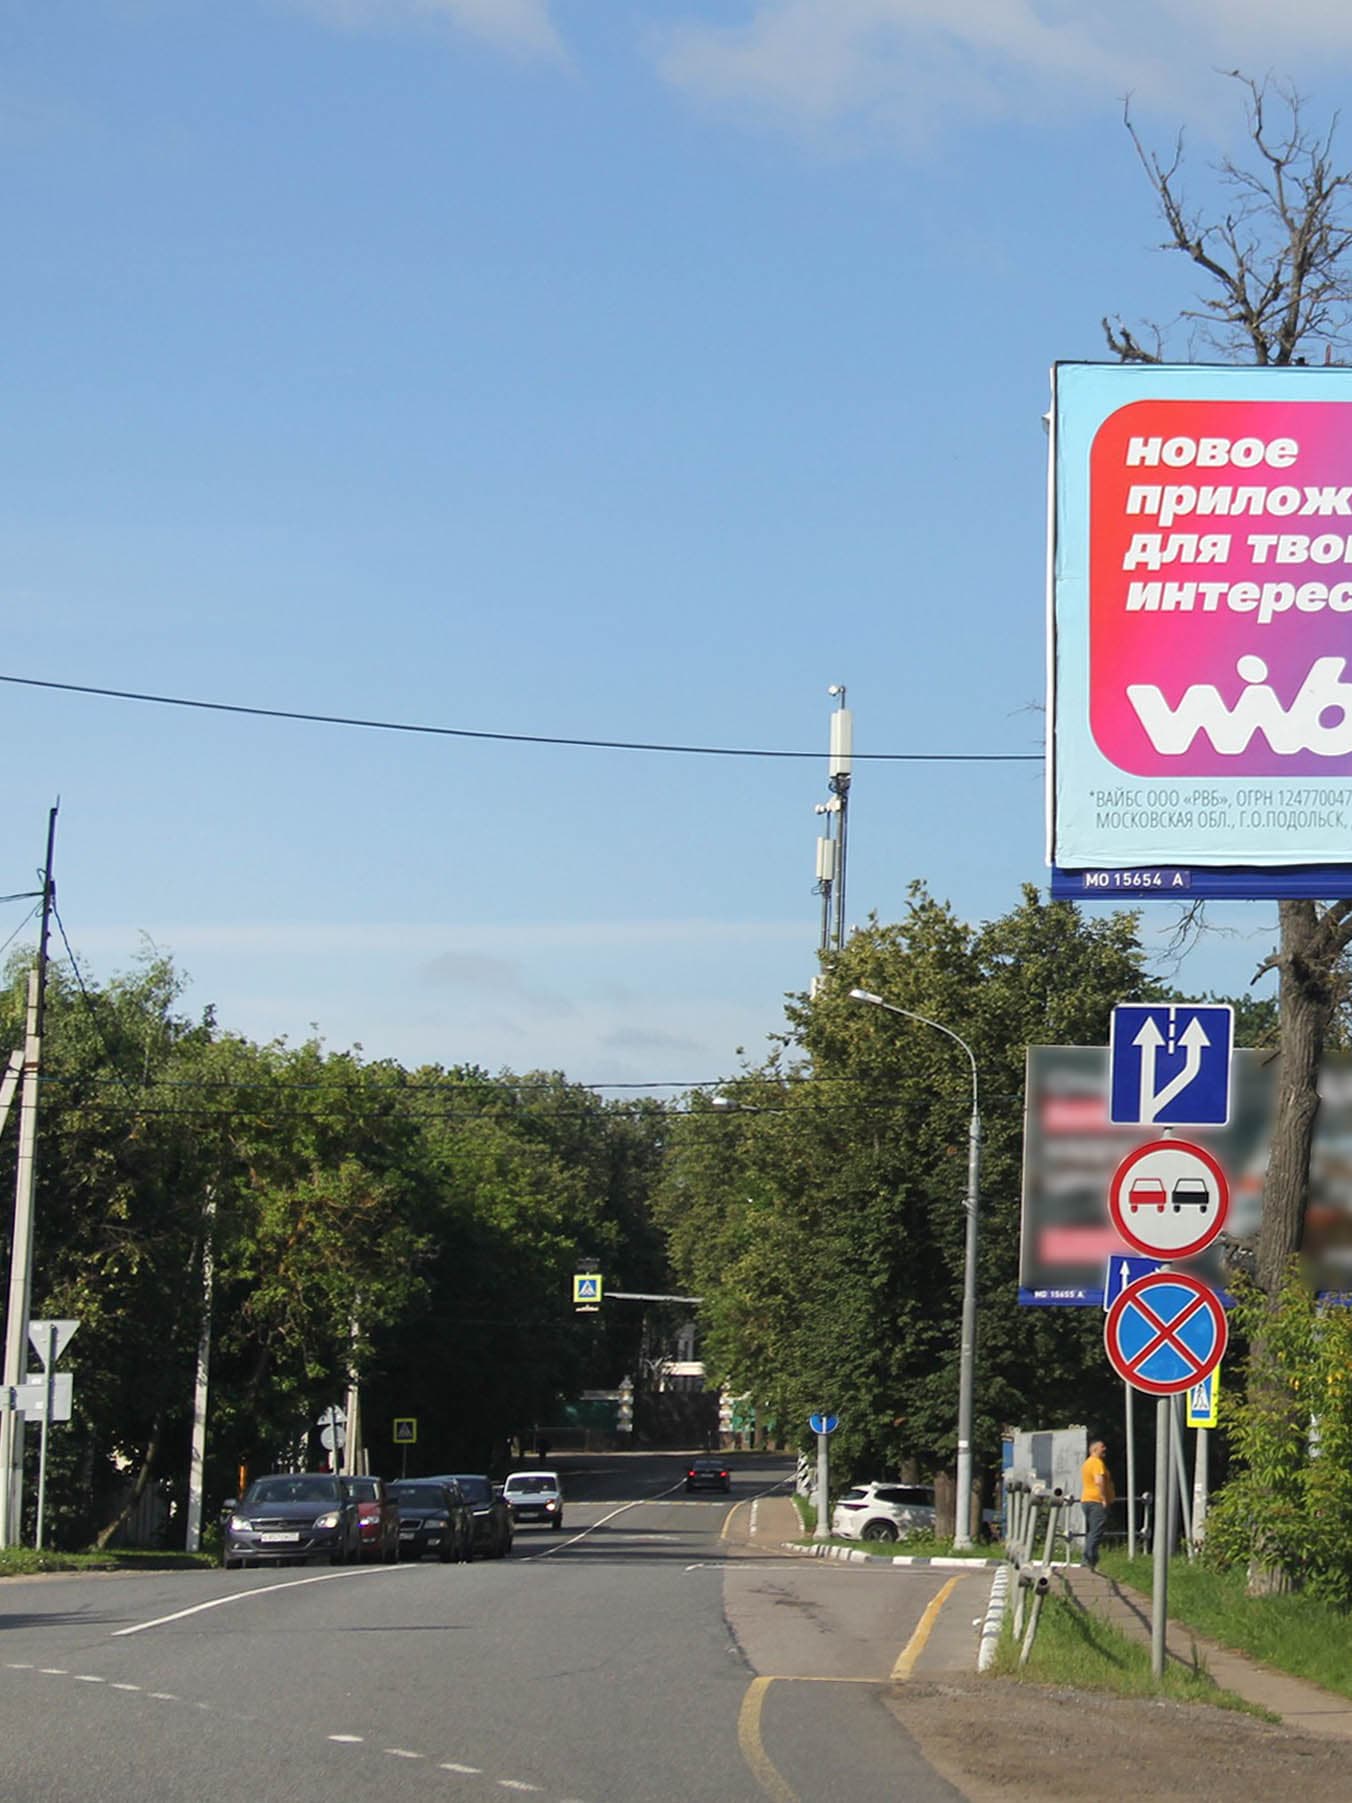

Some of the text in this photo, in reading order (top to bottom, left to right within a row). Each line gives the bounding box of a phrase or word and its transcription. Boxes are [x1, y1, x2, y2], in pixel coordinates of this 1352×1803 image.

[1125, 437, 1299, 467] новое
[1122, 534, 1231, 570] для
[1147, 790, 1180, 808] ООО
[1236, 790, 1273, 808] ОГРН
[1096, 811, 1193, 829] МОСКОВСКАЯ
[1198, 811, 1236, 830] ОБЛ.,
[1114, 872, 1162, 887] 15654
